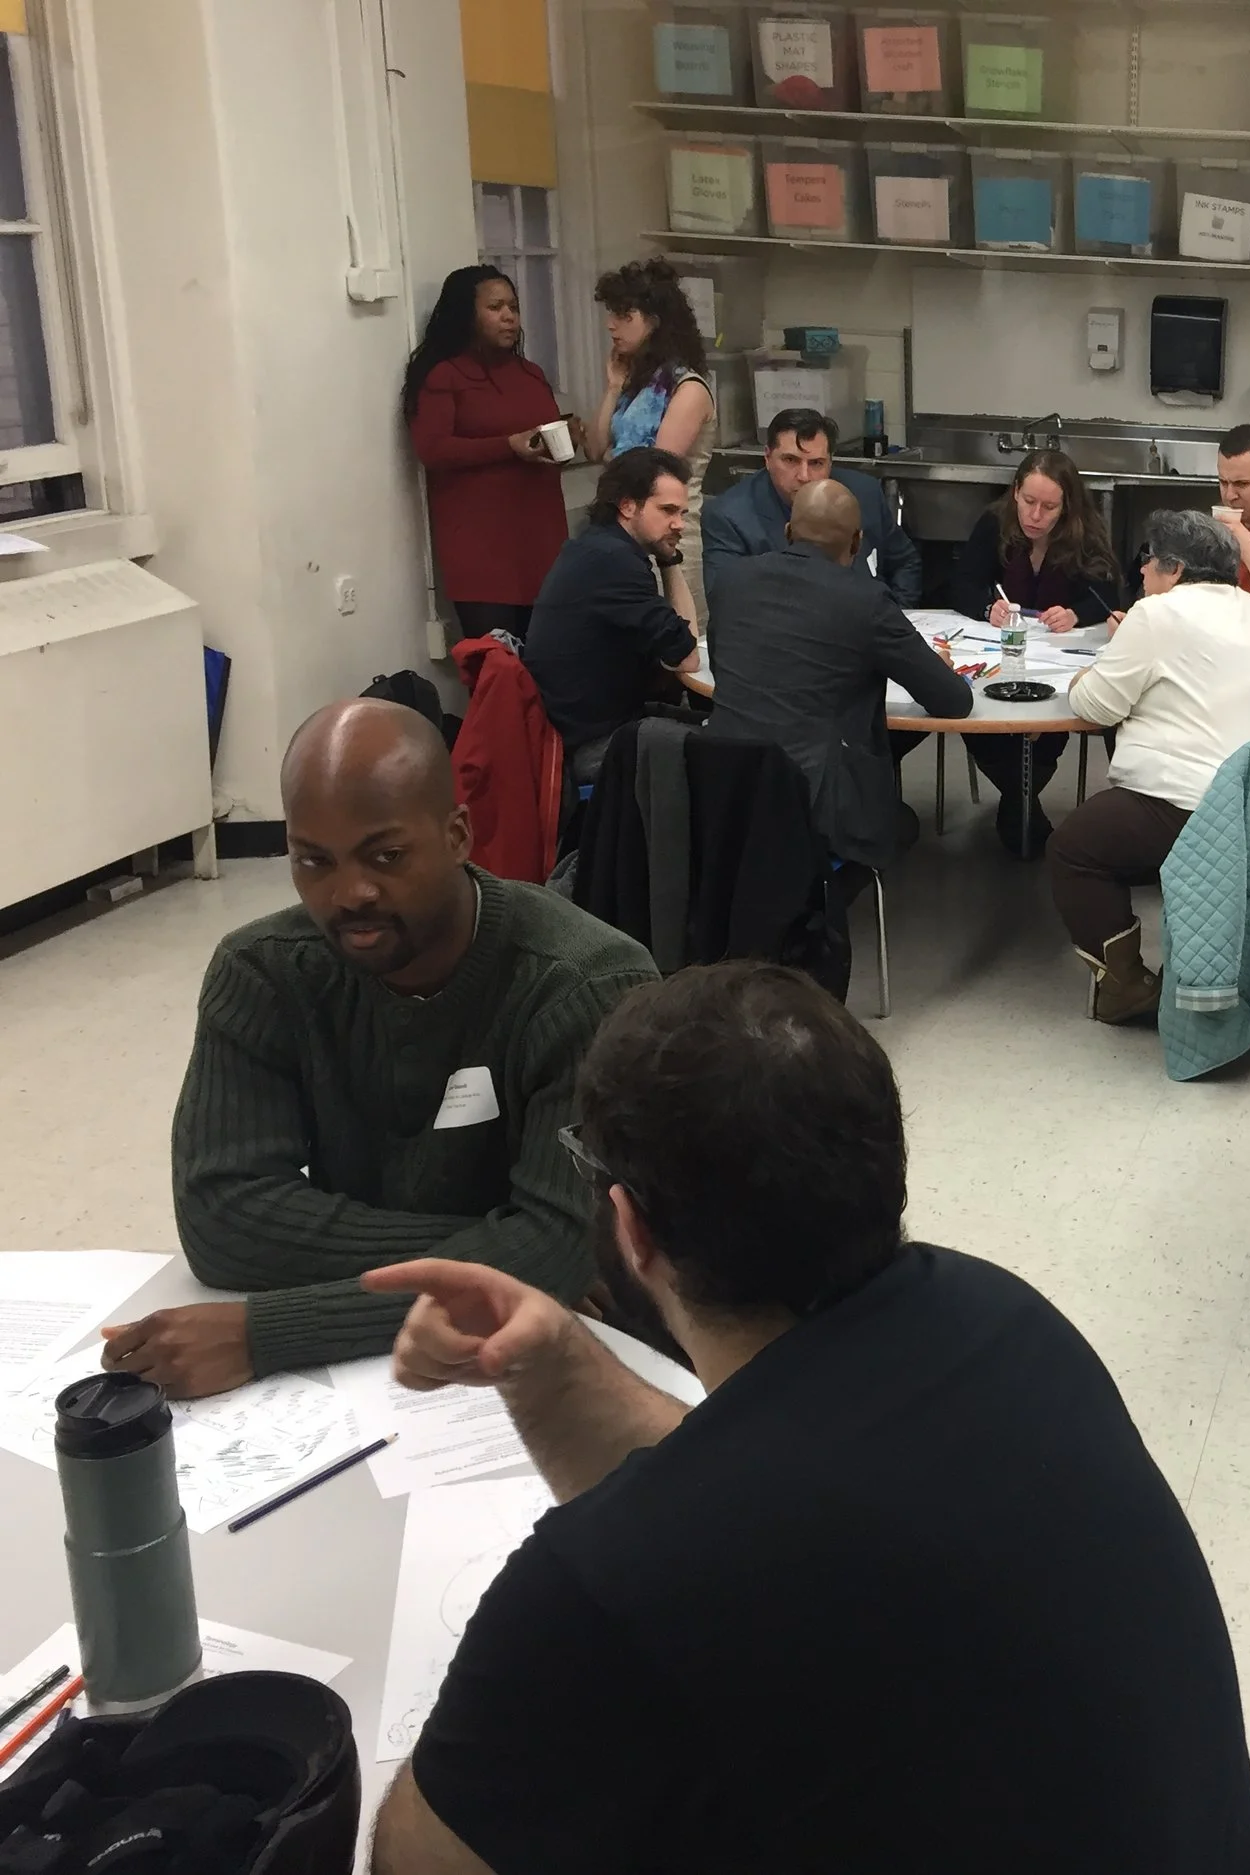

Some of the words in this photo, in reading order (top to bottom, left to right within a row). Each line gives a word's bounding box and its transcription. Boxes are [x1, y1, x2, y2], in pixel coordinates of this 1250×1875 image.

[771, 31, 819, 43] PLASTIC
[782, 46, 806, 56] MAT
[774, 61, 818, 72] SHAPES
[691, 186, 728, 200] Gloves
[1194, 200, 1211, 211] INK
[1211, 202, 1246, 217] STAMPS
